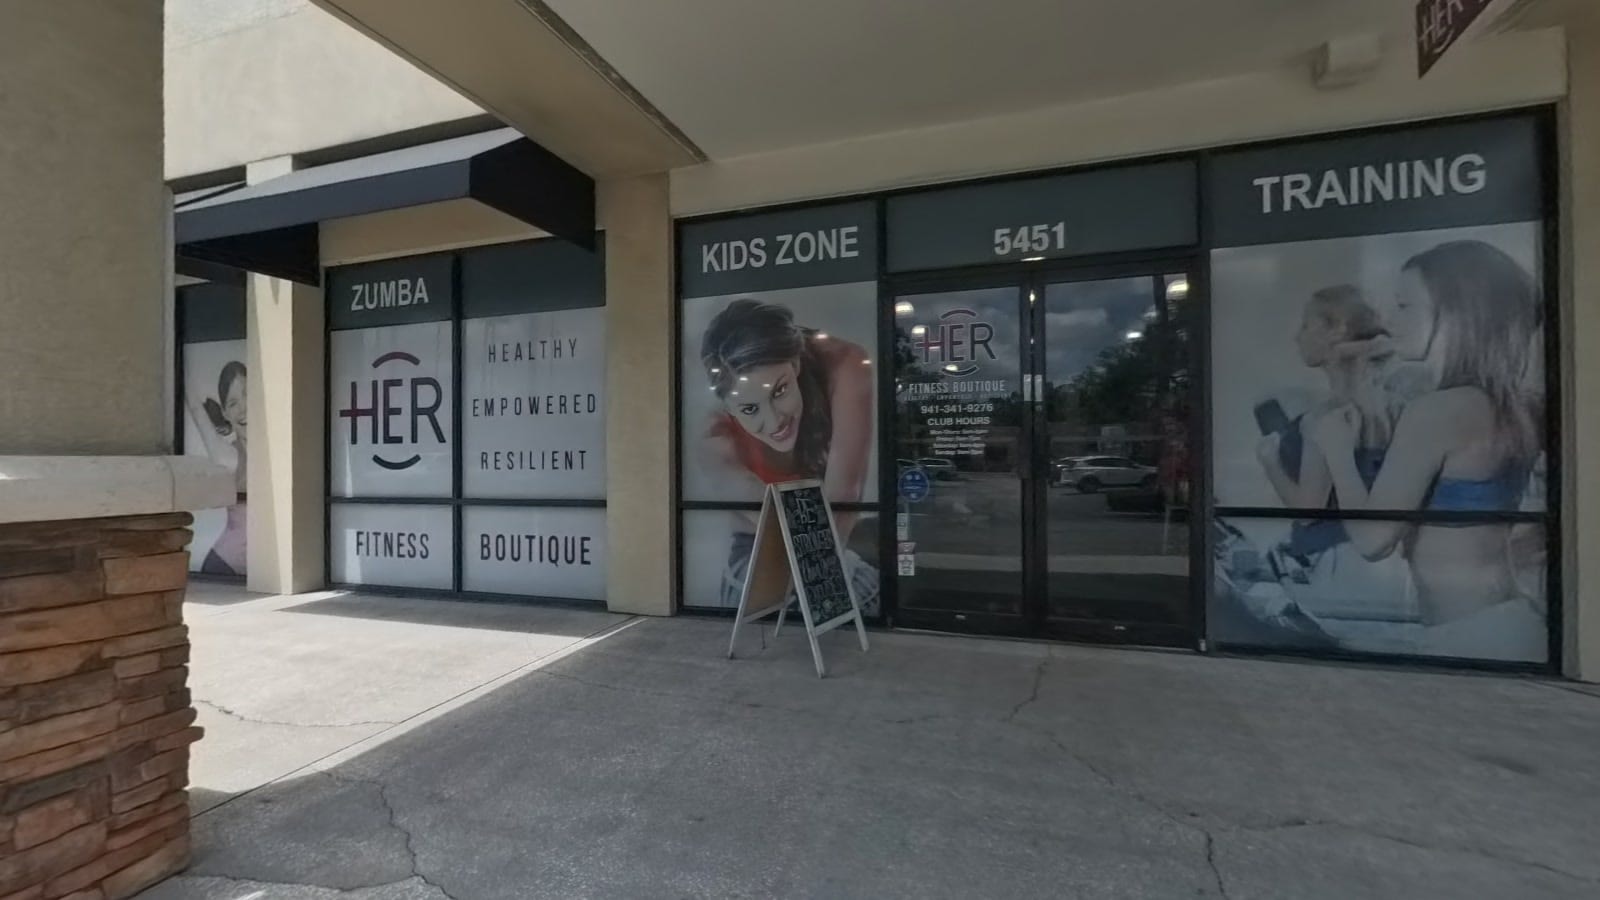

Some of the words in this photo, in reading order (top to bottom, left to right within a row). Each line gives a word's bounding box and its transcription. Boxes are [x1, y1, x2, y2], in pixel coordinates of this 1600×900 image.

[1253, 153, 1486, 214] TRAINING
[702, 237, 767, 273] KIDS
[775, 226, 859, 266] ZONE
[994, 222, 1065, 256] 5451
[351, 277, 429, 311] ZUMBA
[488, 338, 578, 363] HEALTHY
[915, 322, 996, 362] HER
[908, 382, 949, 394] FITNESS
[953, 380, 1006, 393] BOUTIQUE
[339, 376, 447, 445] HER
[472, 393, 597, 417] EMPOWERED
[927, 418, 953, 426] CLUB
[955, 416, 991, 425] HOURS
[480, 450, 588, 471] RESILIENT
[355, 531, 430, 559] FITNESS
[480, 533, 592, 567] BOUTIQUE
